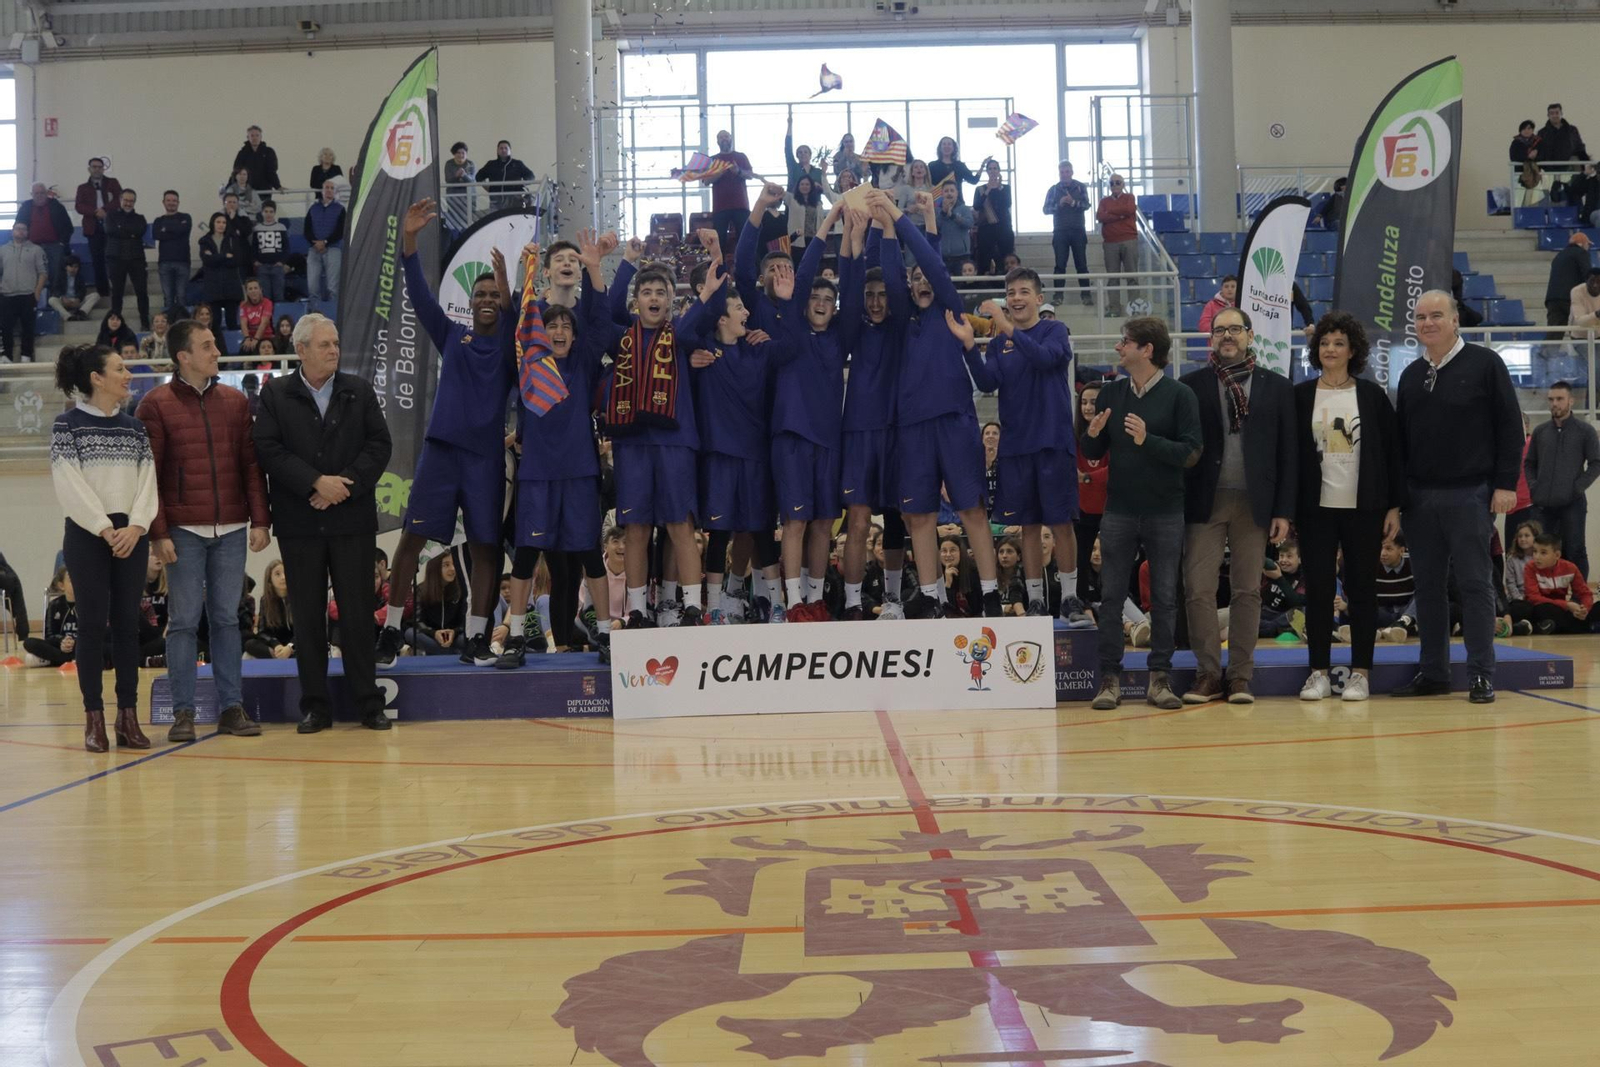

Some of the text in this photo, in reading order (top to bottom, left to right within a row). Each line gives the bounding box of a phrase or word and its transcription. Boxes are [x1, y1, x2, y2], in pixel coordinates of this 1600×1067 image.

[375, 214, 398, 321] Andaluza
[1374, 225, 1400, 332] Andaluza
[653, 331, 673, 380] FCB
[395, 383, 414, 409] de
[698, 649, 934, 690] ¡CAMPEONES!
[1331, 666, 1351, 694] 3
[567, 698, 610, 707] DIPUTACIÓN
[568, 705, 609, 714] DE ALMERÍA
[512, 822, 613, 842] de
[320, 843, 525, 880] Vera
